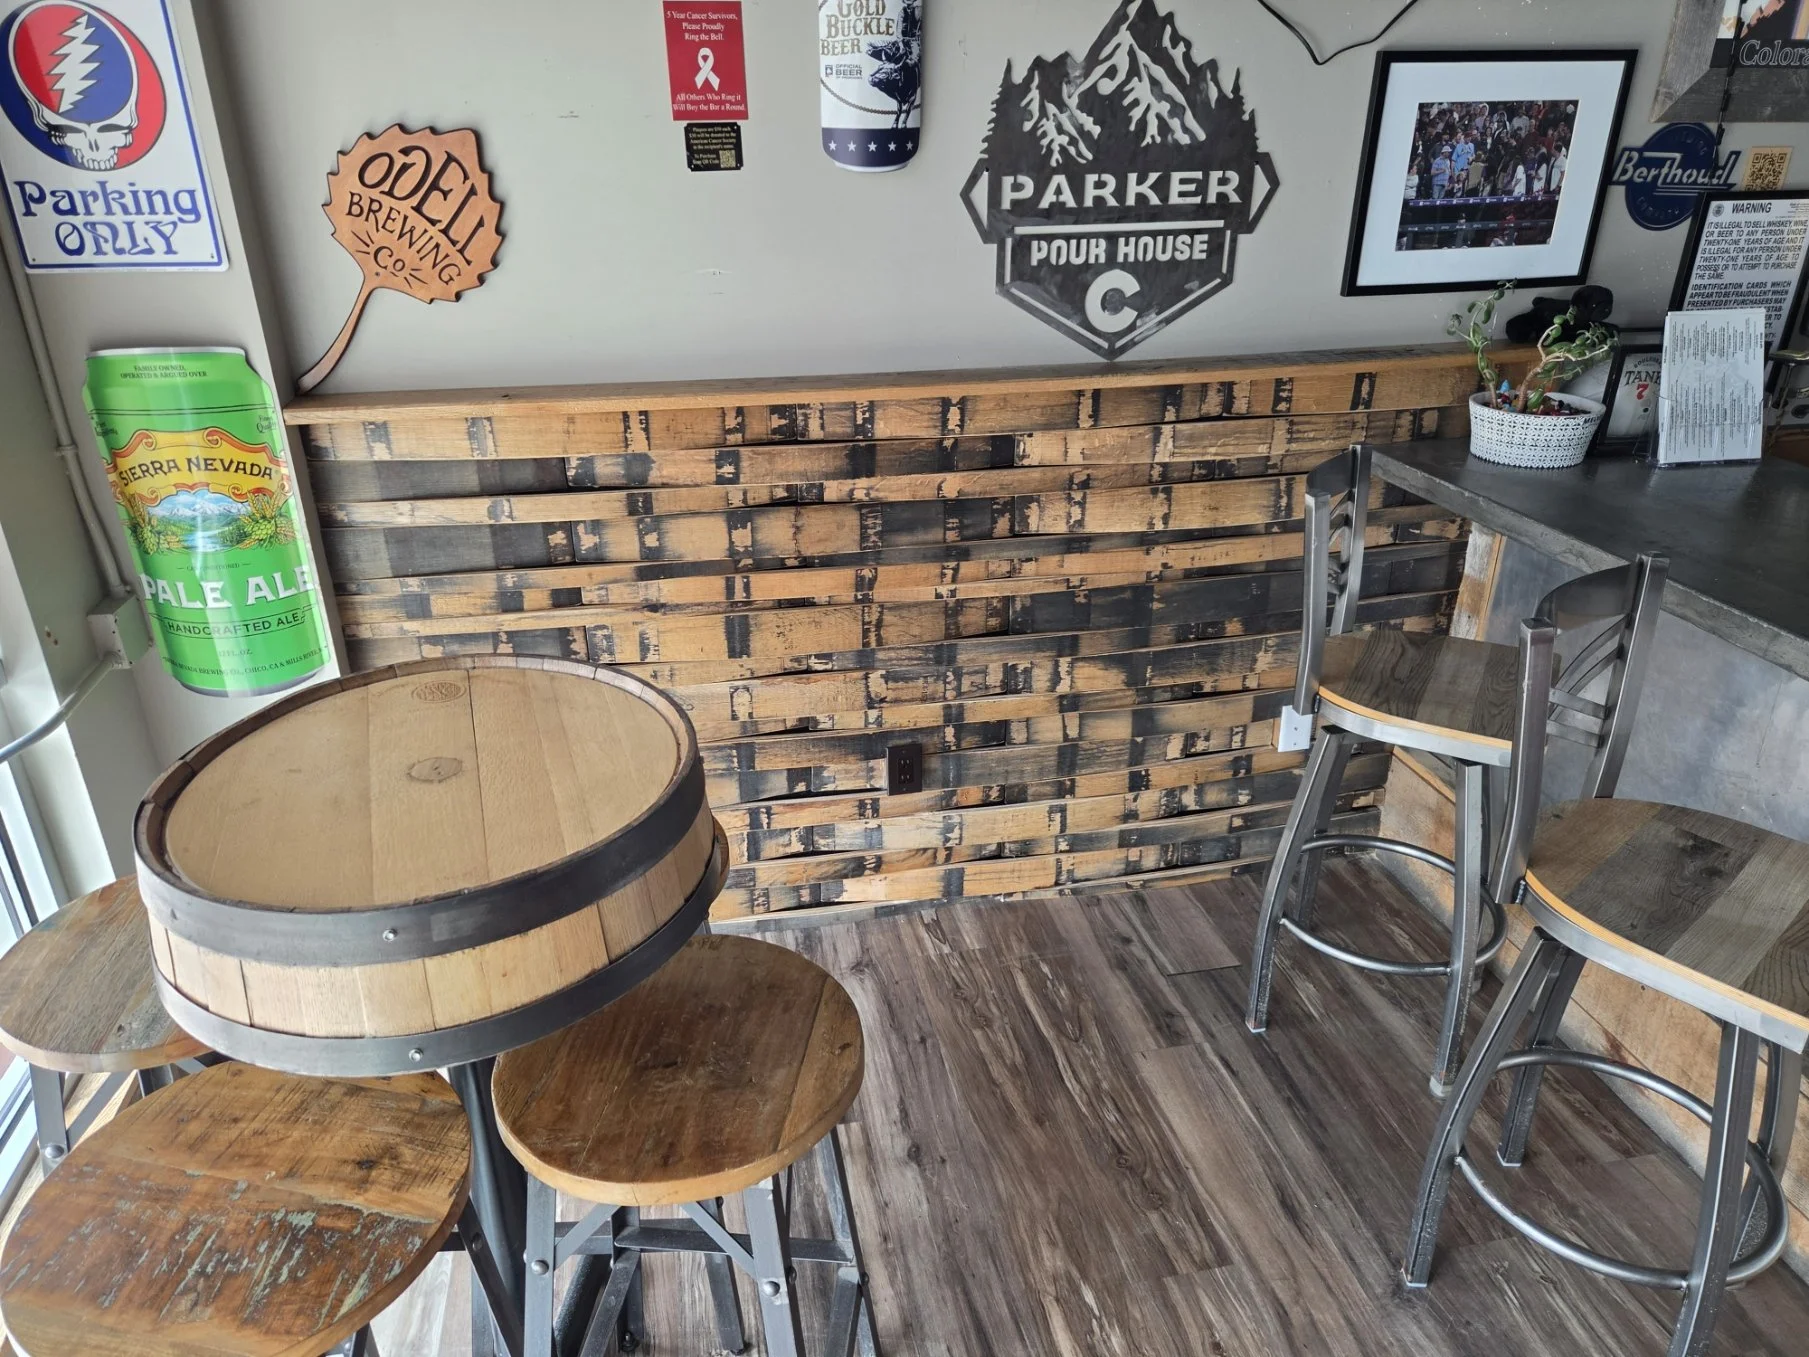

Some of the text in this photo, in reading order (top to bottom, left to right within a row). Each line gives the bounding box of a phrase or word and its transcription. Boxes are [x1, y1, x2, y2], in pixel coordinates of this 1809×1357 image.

[708, 12, 738, 20] Survivors,
[838, 0, 886, 18] GOLD
[682, 22, 725, 31] Please Proudly
[826, 14, 895, 38] BUCKLE
[684, 33, 699, 42] Ring
[820, 38, 862, 56] BEER
[721, 94, 735, 102] Ring
[1612, 150, 1737, 187] Berthoud
[1000, 170, 1243, 210] PARKER
[14, 180, 202, 224] Parking
[357, 144, 485, 266] ODELL
[1732, 202, 1772, 214] WARNING
[54, 221, 179, 256] ONLY
[345, 191, 462, 286] BREWING
[1030, 234, 1209, 266] POUR HOUSE
[1689, 291, 1715, 299] APPEAR
[1732, 290, 1771, 298] FRAUDULENT
[1692, 283, 1743, 291] IDENTIFICATION
[1085, 268, 1141, 334] C
[1732, 298, 1773, 306] PURCHASERS
[1636, 383, 1650, 400] 7
[118, 455, 273, 487] SIERRA NEVADA
[139, 565, 315, 609] PALE ALE
[168, 612, 300, 636] HANDCRAFTED ALE
[269, 662, 279, 670] CA
[286, 656, 303, 665] MILLS
